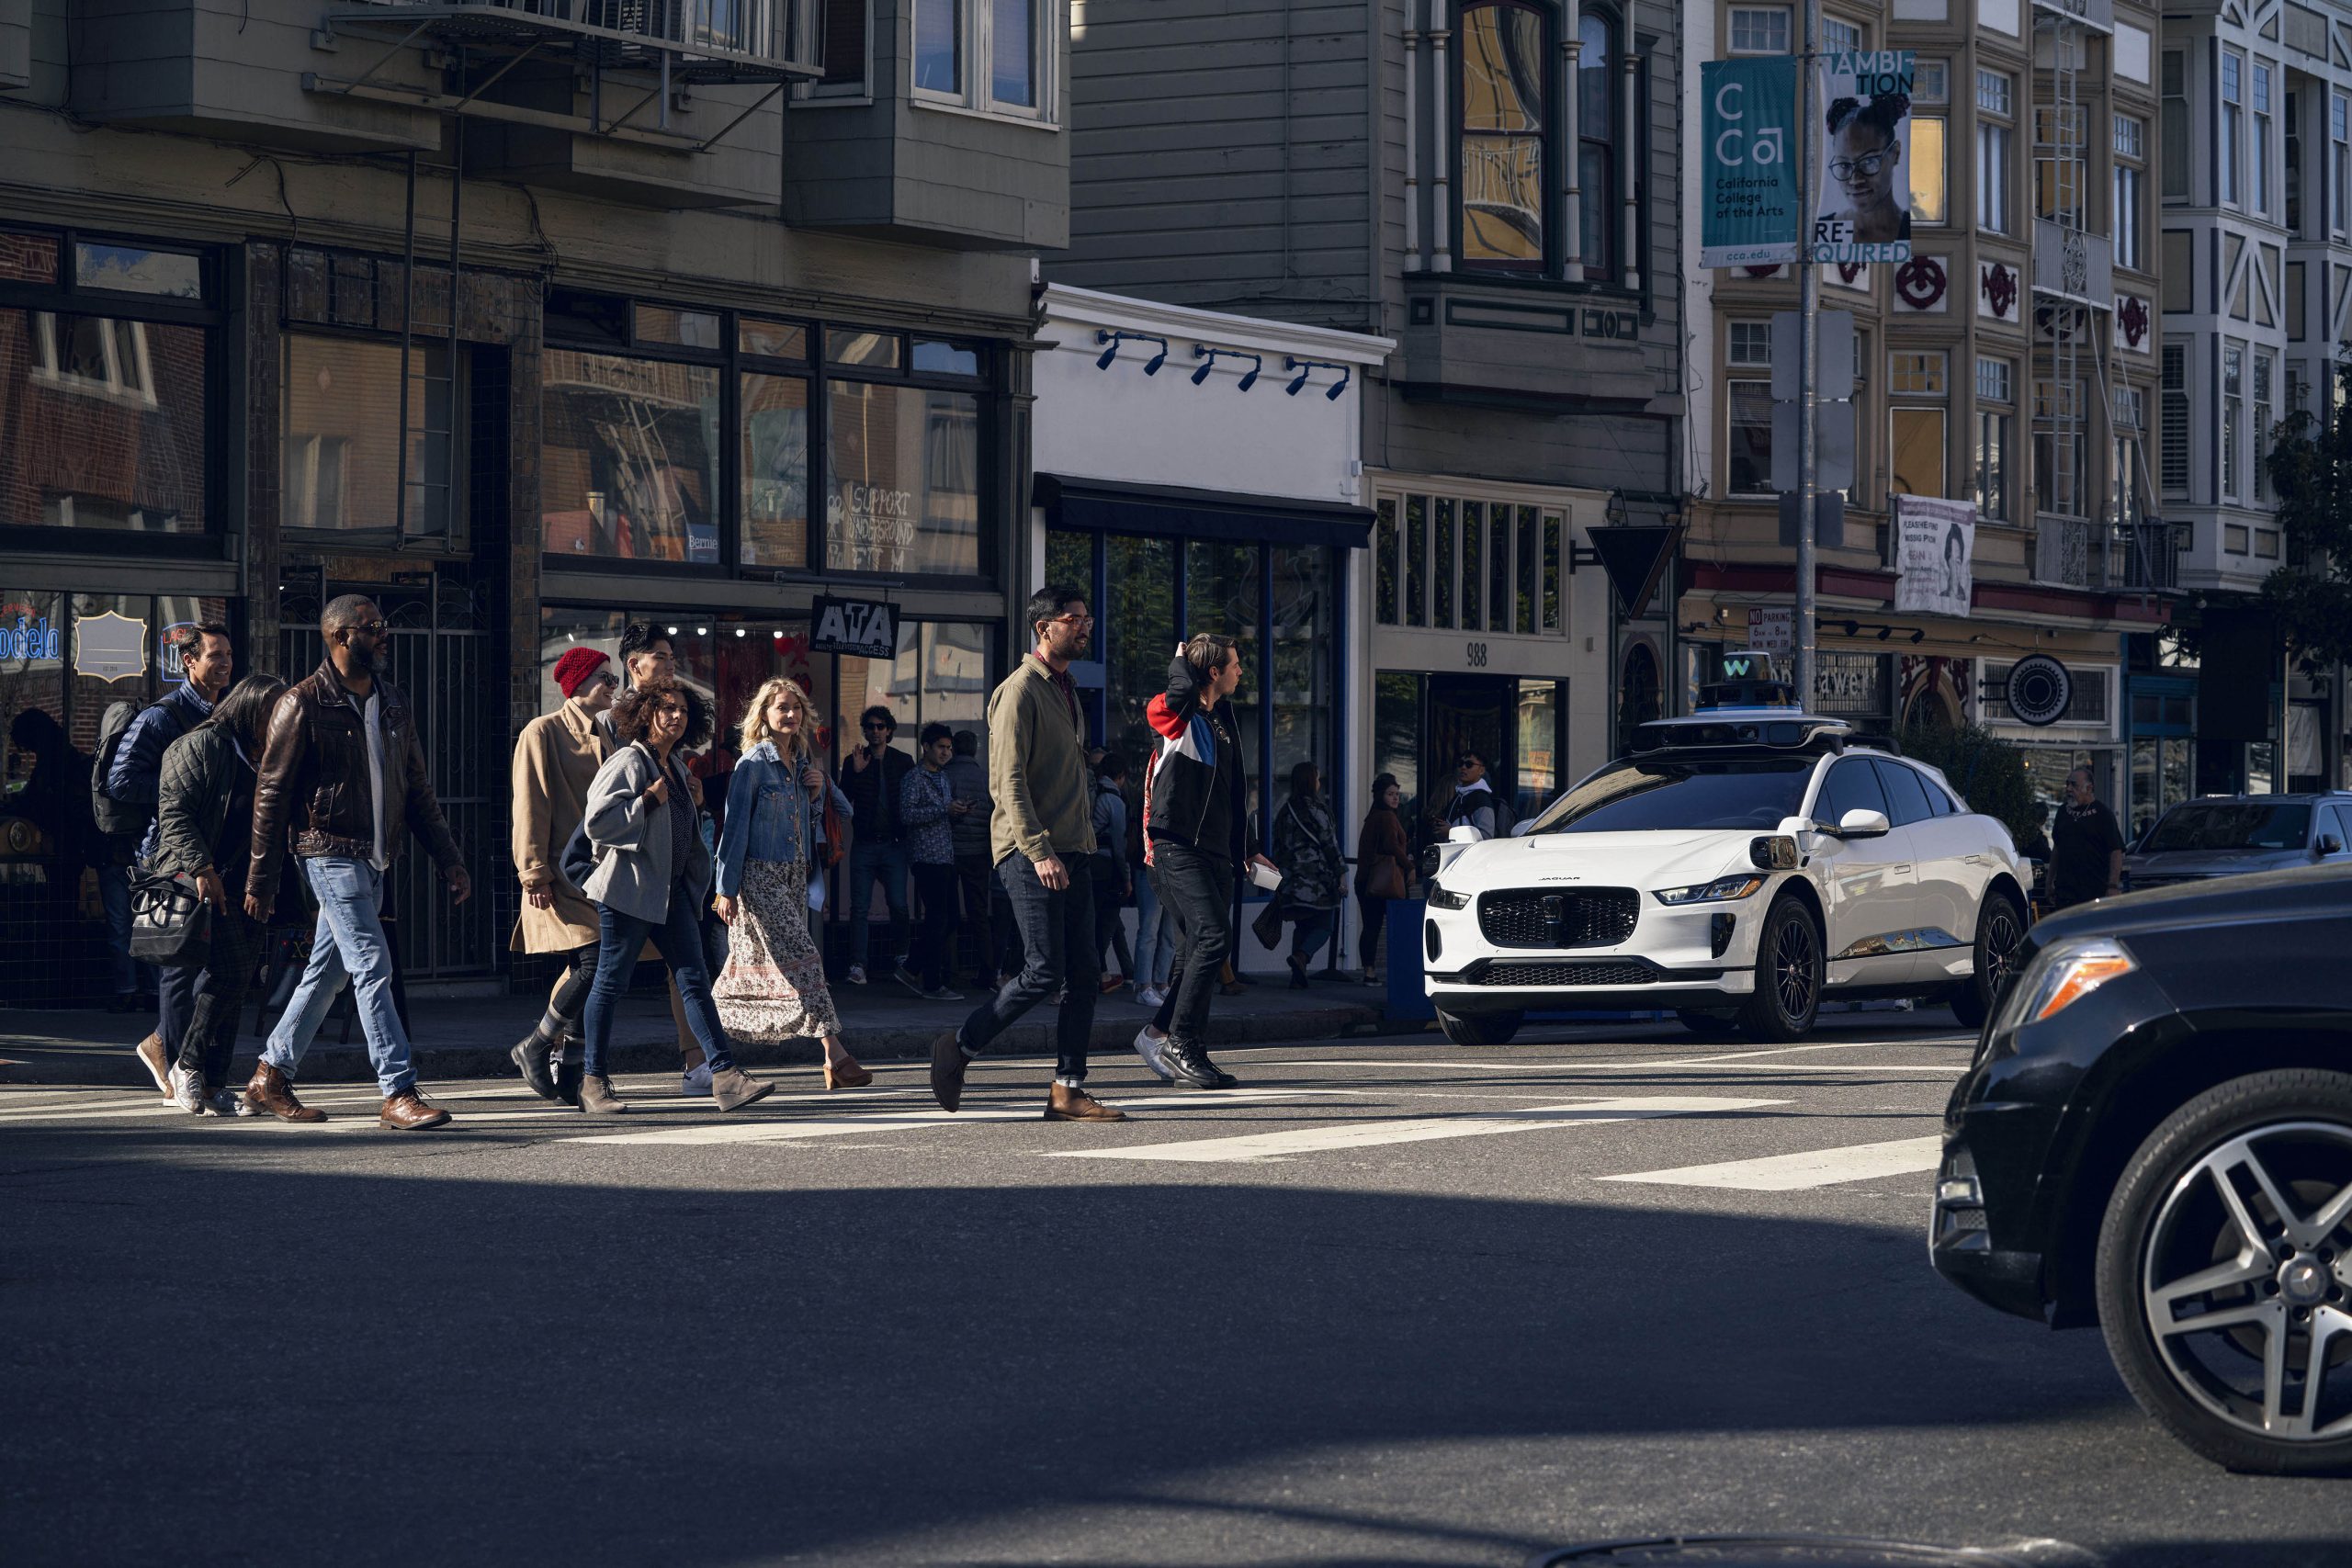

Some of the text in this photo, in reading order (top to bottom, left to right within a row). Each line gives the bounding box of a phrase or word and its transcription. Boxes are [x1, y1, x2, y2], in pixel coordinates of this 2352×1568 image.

[1836, 51, 1915, 74] AMBI-
[1856, 73, 1914, 94] TION
[1715, 176, 1779, 190] California
[1715, 191, 1761, 206] College
[1715, 205, 1784, 219] of the Arts
[1815, 222, 1854, 243] RE-
[1726, 251, 1770, 261] cca.edu
[1815, 243, 1910, 263] QUIRED
[852, 487, 911, 516] SUPPORT
[848, 517, 914, 546] UNDERGROUND
[688, 535, 718, 549] Bernie
[0, 603, 37, 618] ERVEZA
[1749, 610, 1791, 624] NO PARKING
[816, 603, 892, 647] ATA
[0, 616, 60, 660] odelo
[859, 645, 890, 657] ACCESS
[1466, 642, 1487, 667] 988
